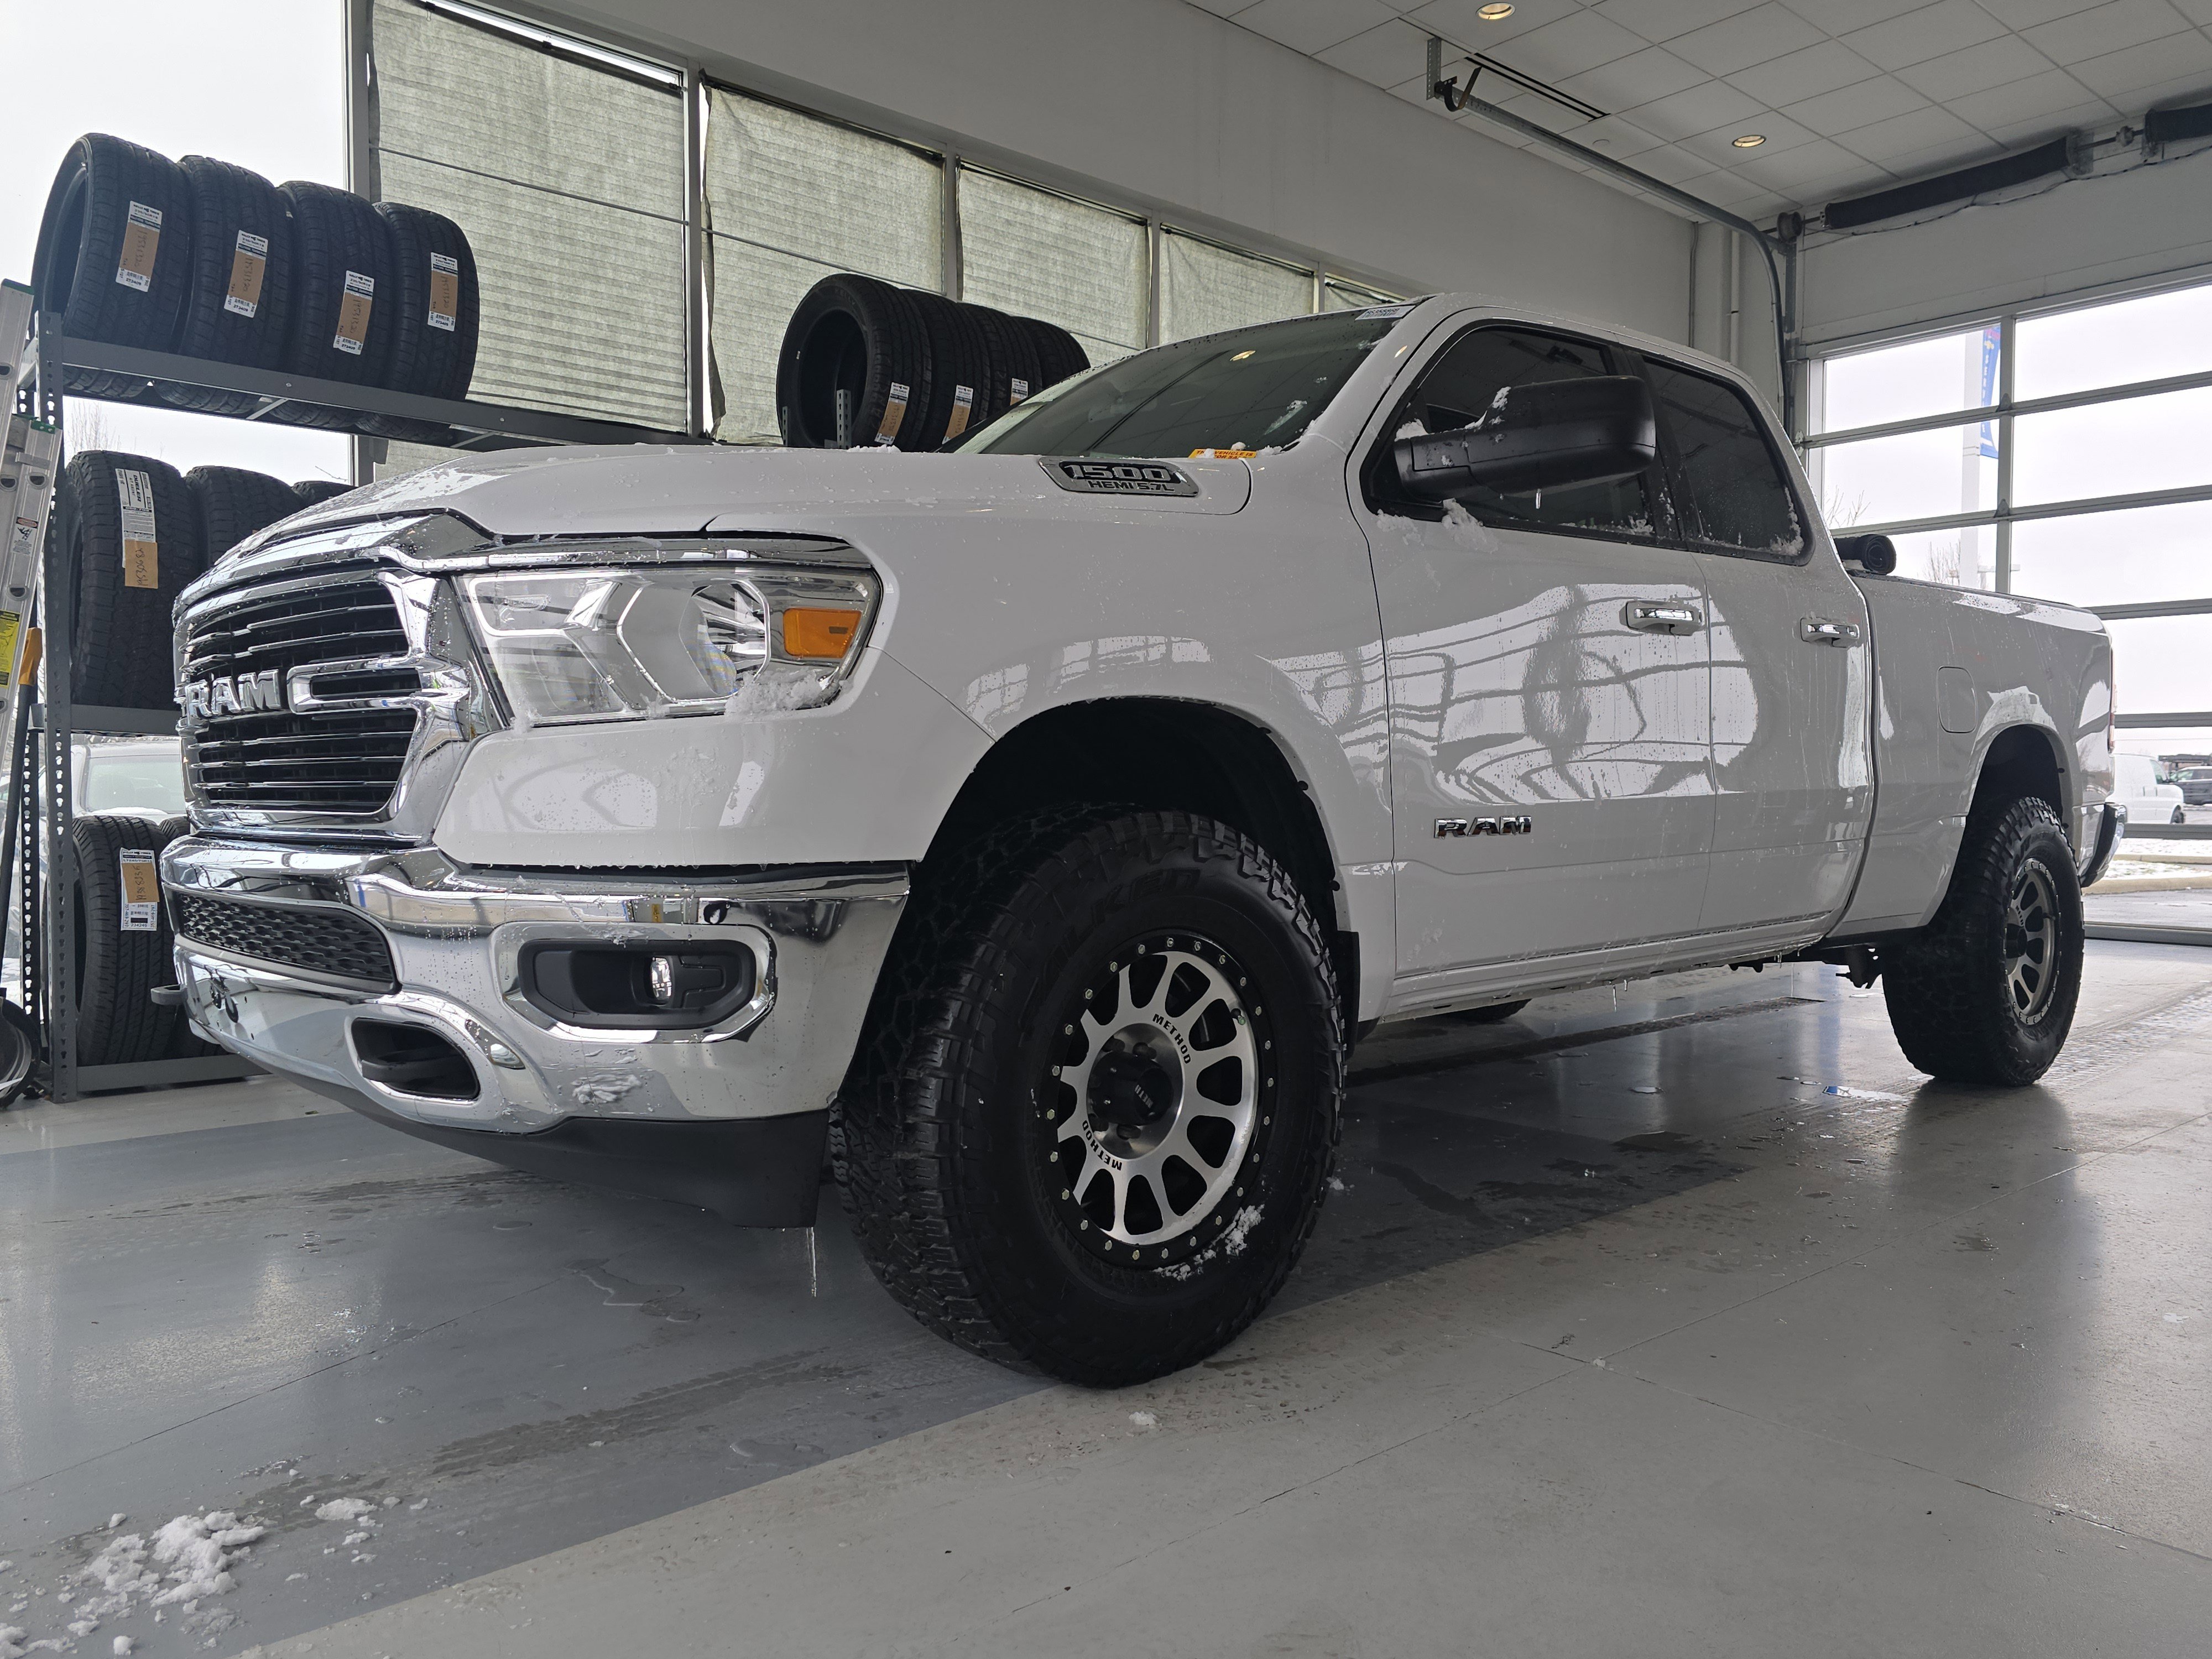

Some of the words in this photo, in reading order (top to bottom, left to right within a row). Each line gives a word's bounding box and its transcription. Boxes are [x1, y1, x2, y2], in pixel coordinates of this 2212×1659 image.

[1064, 465, 1171, 481] 1500
[1088, 480, 1134, 490] HEMI
[1136, 482, 1175, 492] 5.7L
[133, 474, 142, 502] DUELER
[186, 669, 280, 718] RAM
[1434, 816, 1532, 838] RAM
[1152, 1013, 1191, 1064] METHOD
[1082, 1120, 1122, 1171] METHOD
